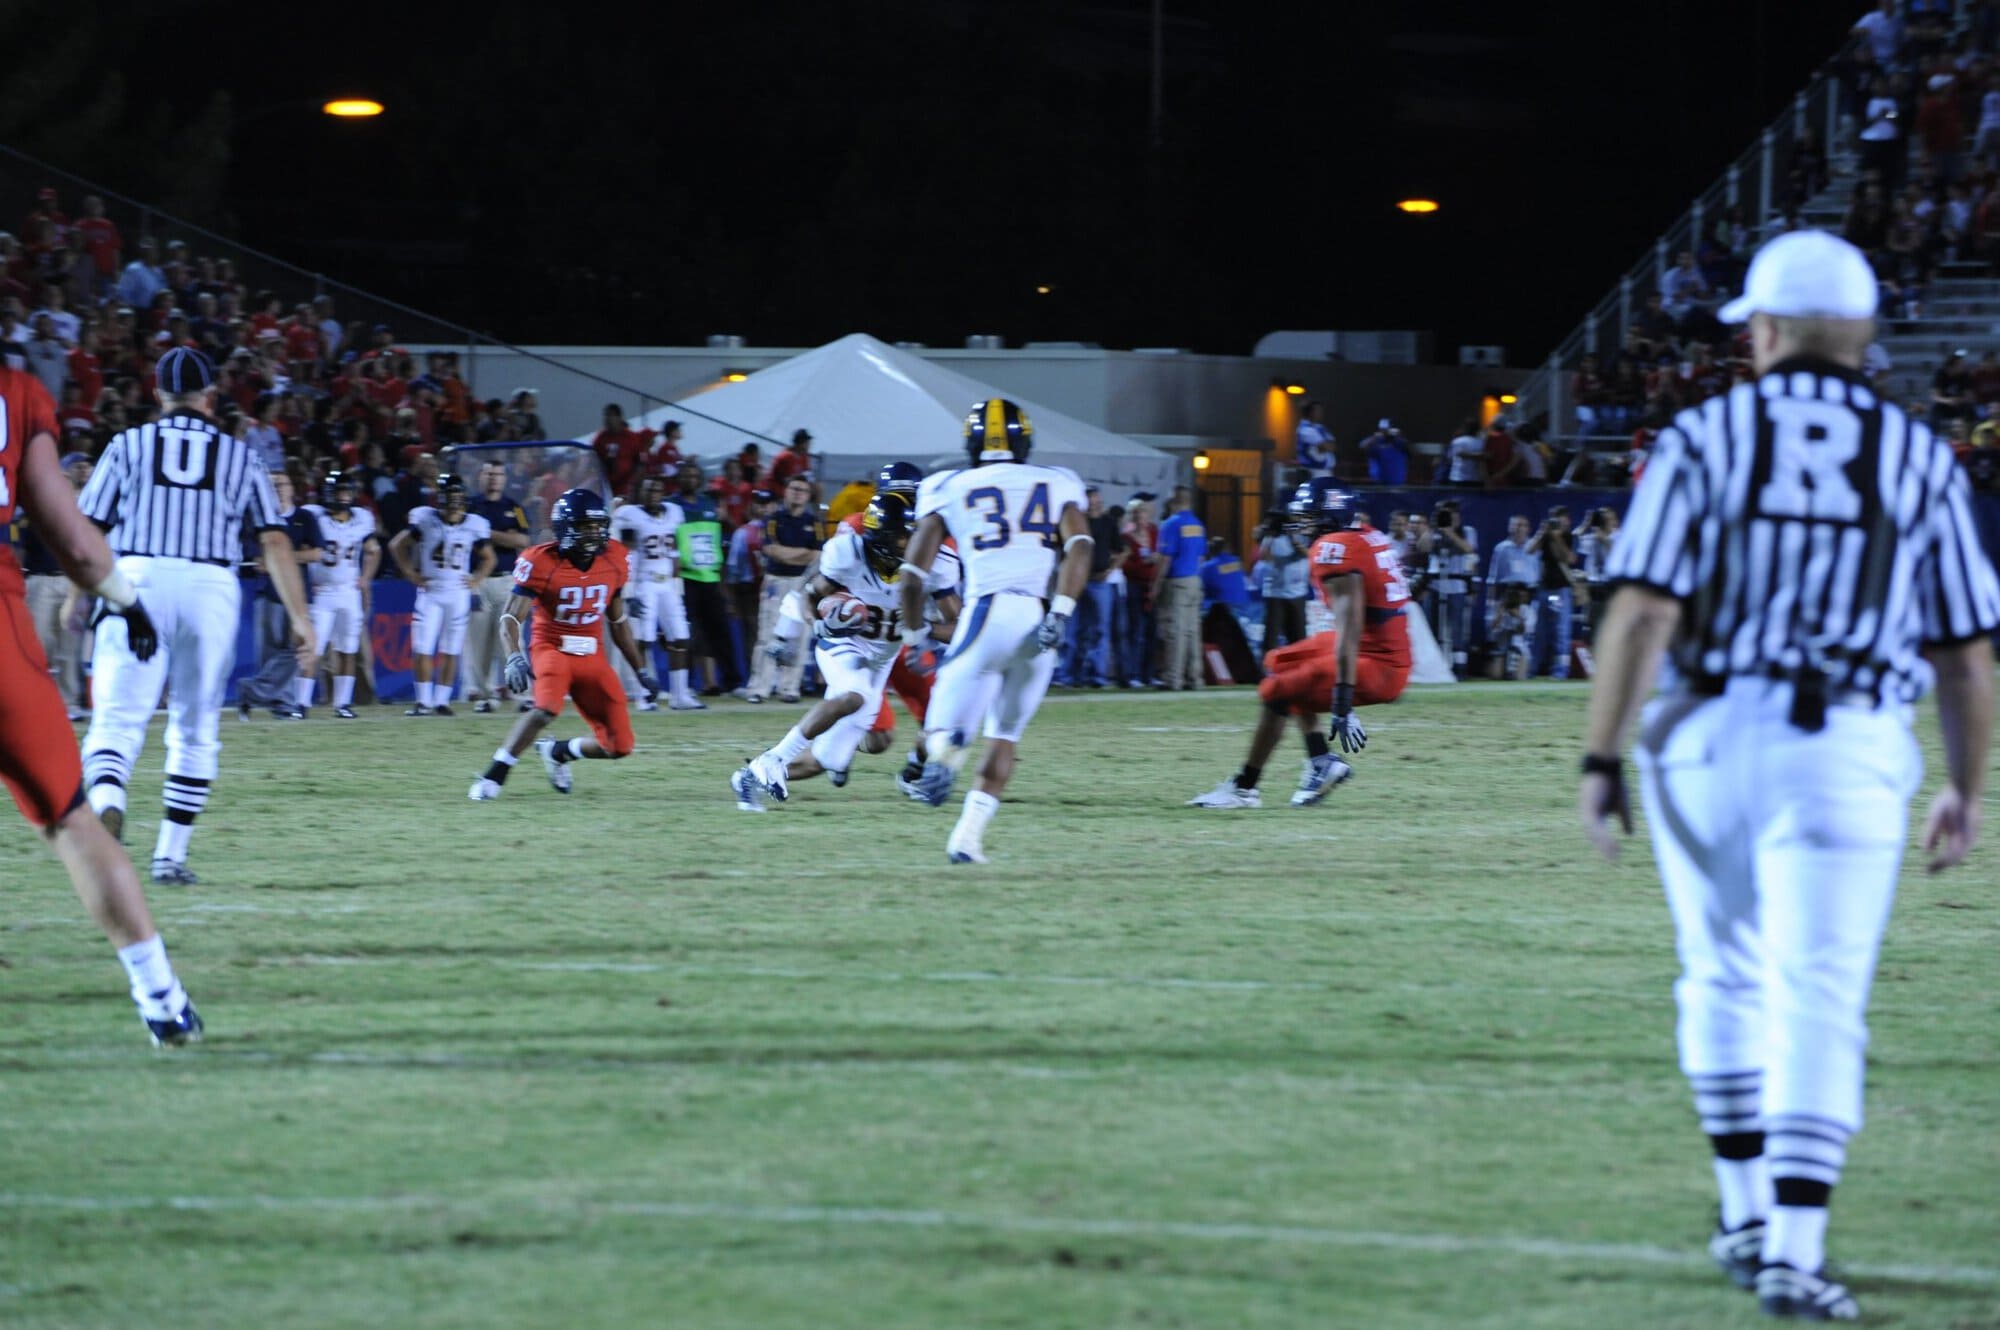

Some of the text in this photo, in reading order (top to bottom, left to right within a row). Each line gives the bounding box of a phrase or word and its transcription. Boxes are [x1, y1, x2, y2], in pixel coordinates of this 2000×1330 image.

[158, 427, 213, 485] U
[1759, 399, 1863, 521] R
[964, 483, 1060, 551] 34
[554, 584, 610, 625] 23
